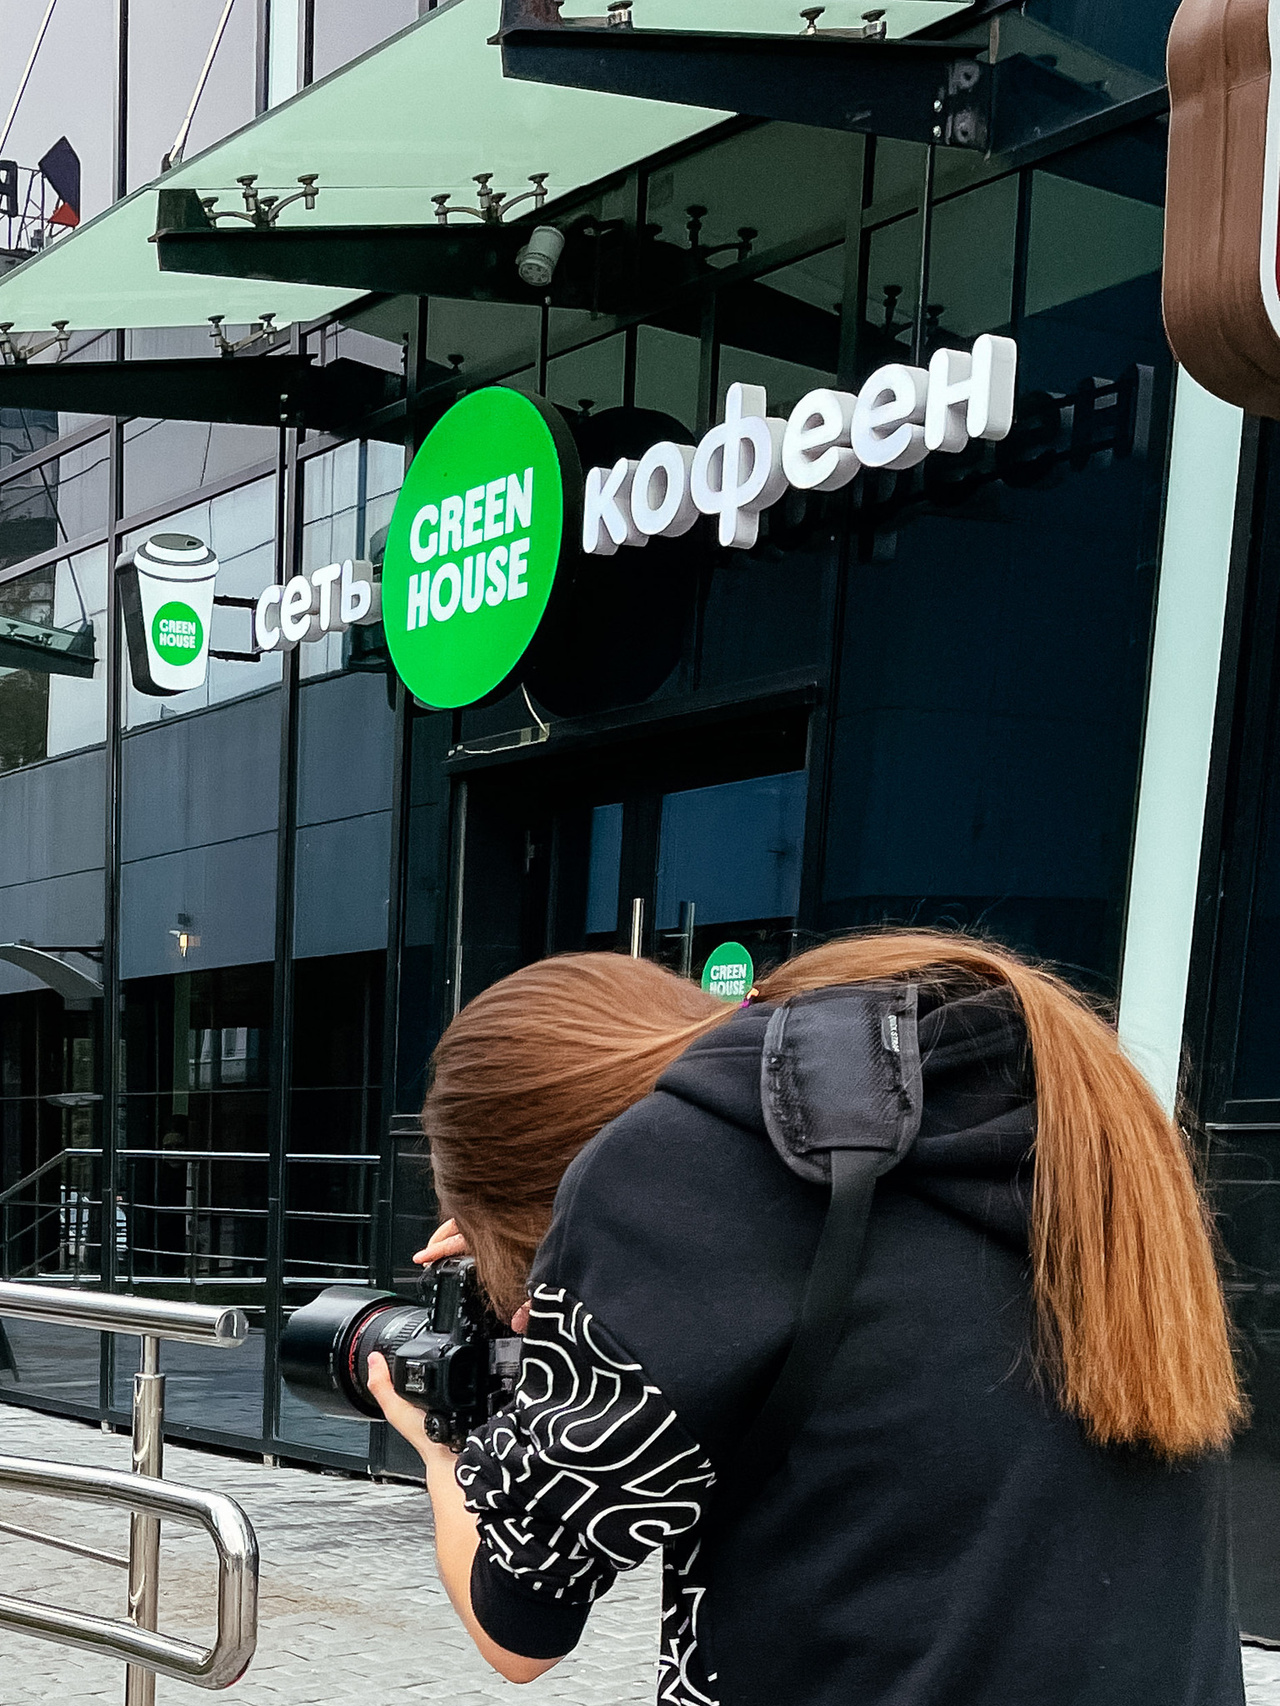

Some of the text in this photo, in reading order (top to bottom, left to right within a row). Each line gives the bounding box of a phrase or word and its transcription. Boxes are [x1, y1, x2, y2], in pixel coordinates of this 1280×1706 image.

[582, 334, 1017, 555] кофеен
[409, 466, 534, 564] GREEN
[255, 559, 378, 651] сеть
[406, 536, 531, 632] HOUSE
[158, 618, 197, 635] GREEN
[158, 632, 197, 649] HOUSE
[709, 980, 747, 997] HOUSE
[710, 963, 748, 981] GREEN
